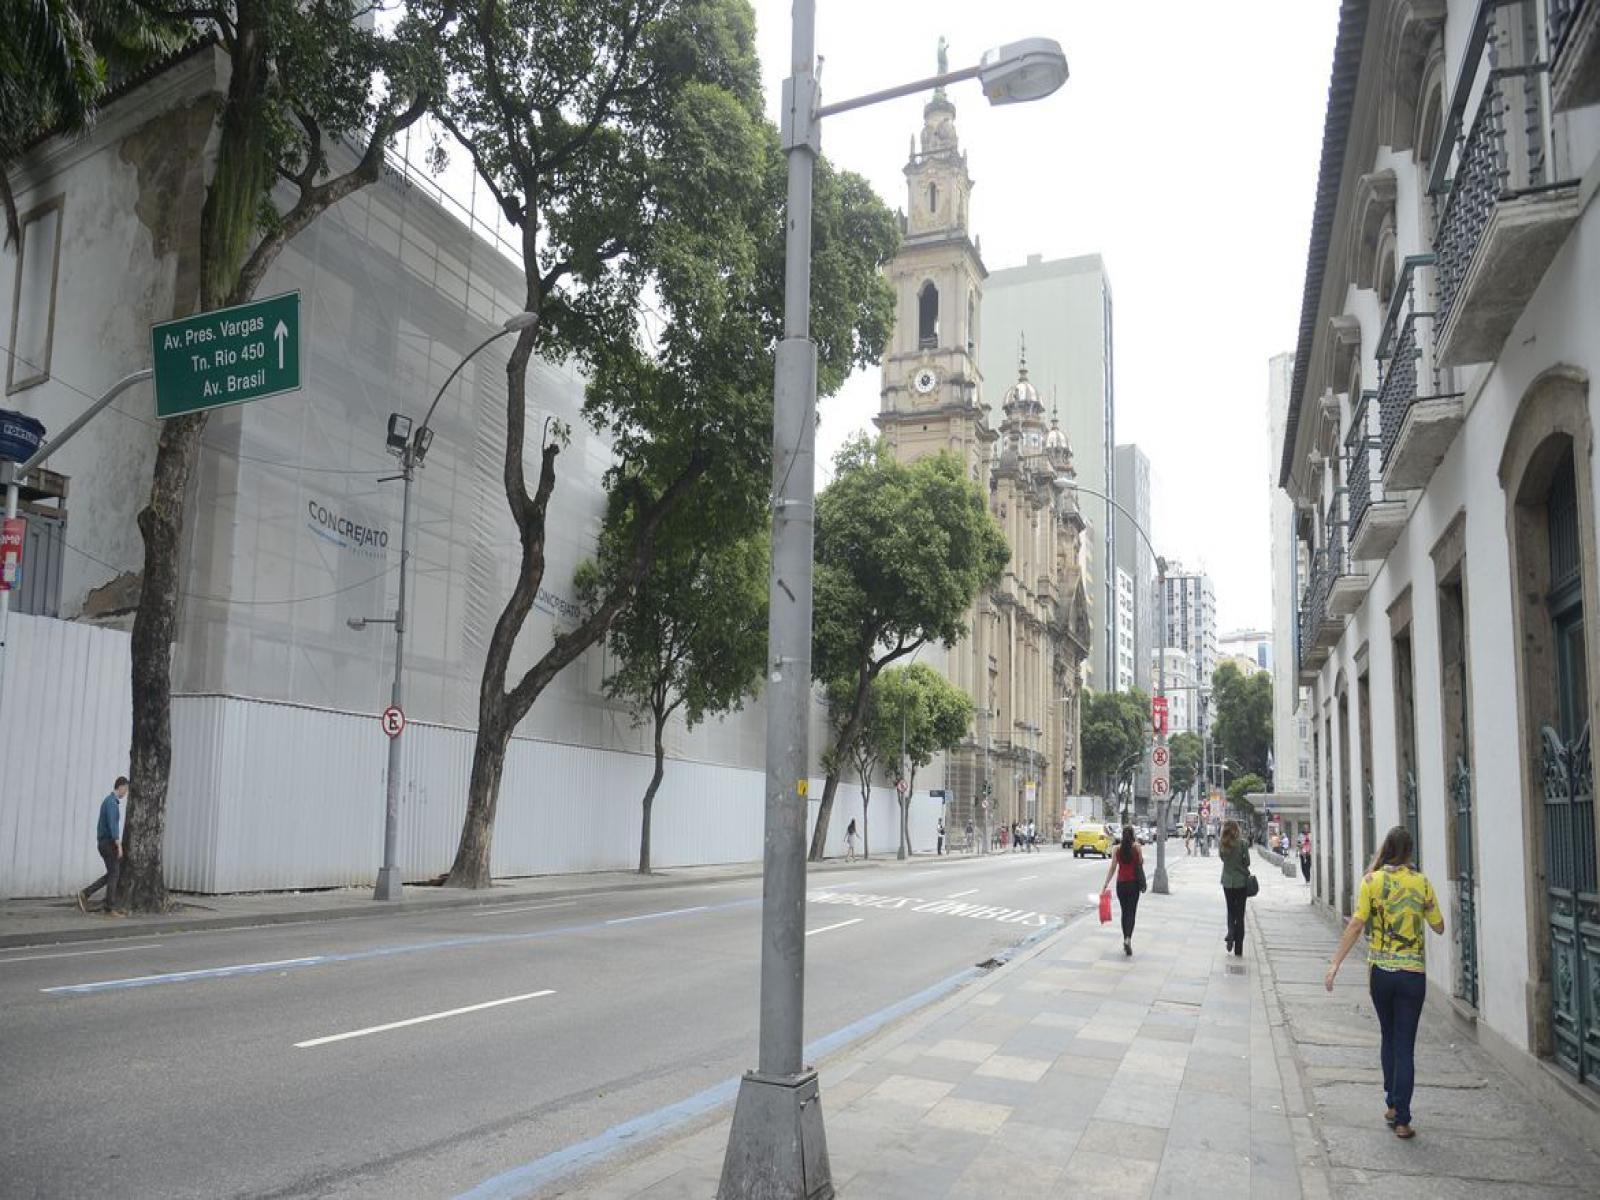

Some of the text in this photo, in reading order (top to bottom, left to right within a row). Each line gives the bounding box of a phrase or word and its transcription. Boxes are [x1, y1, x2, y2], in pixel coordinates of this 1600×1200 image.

[163, 315, 265, 350] Av. Pres. Vargas
[191, 342, 265, 373] Tn. Rio 450
[203, 368, 265, 397] Av. Brasil
[308, 500, 388, 548] CONCREJATO
